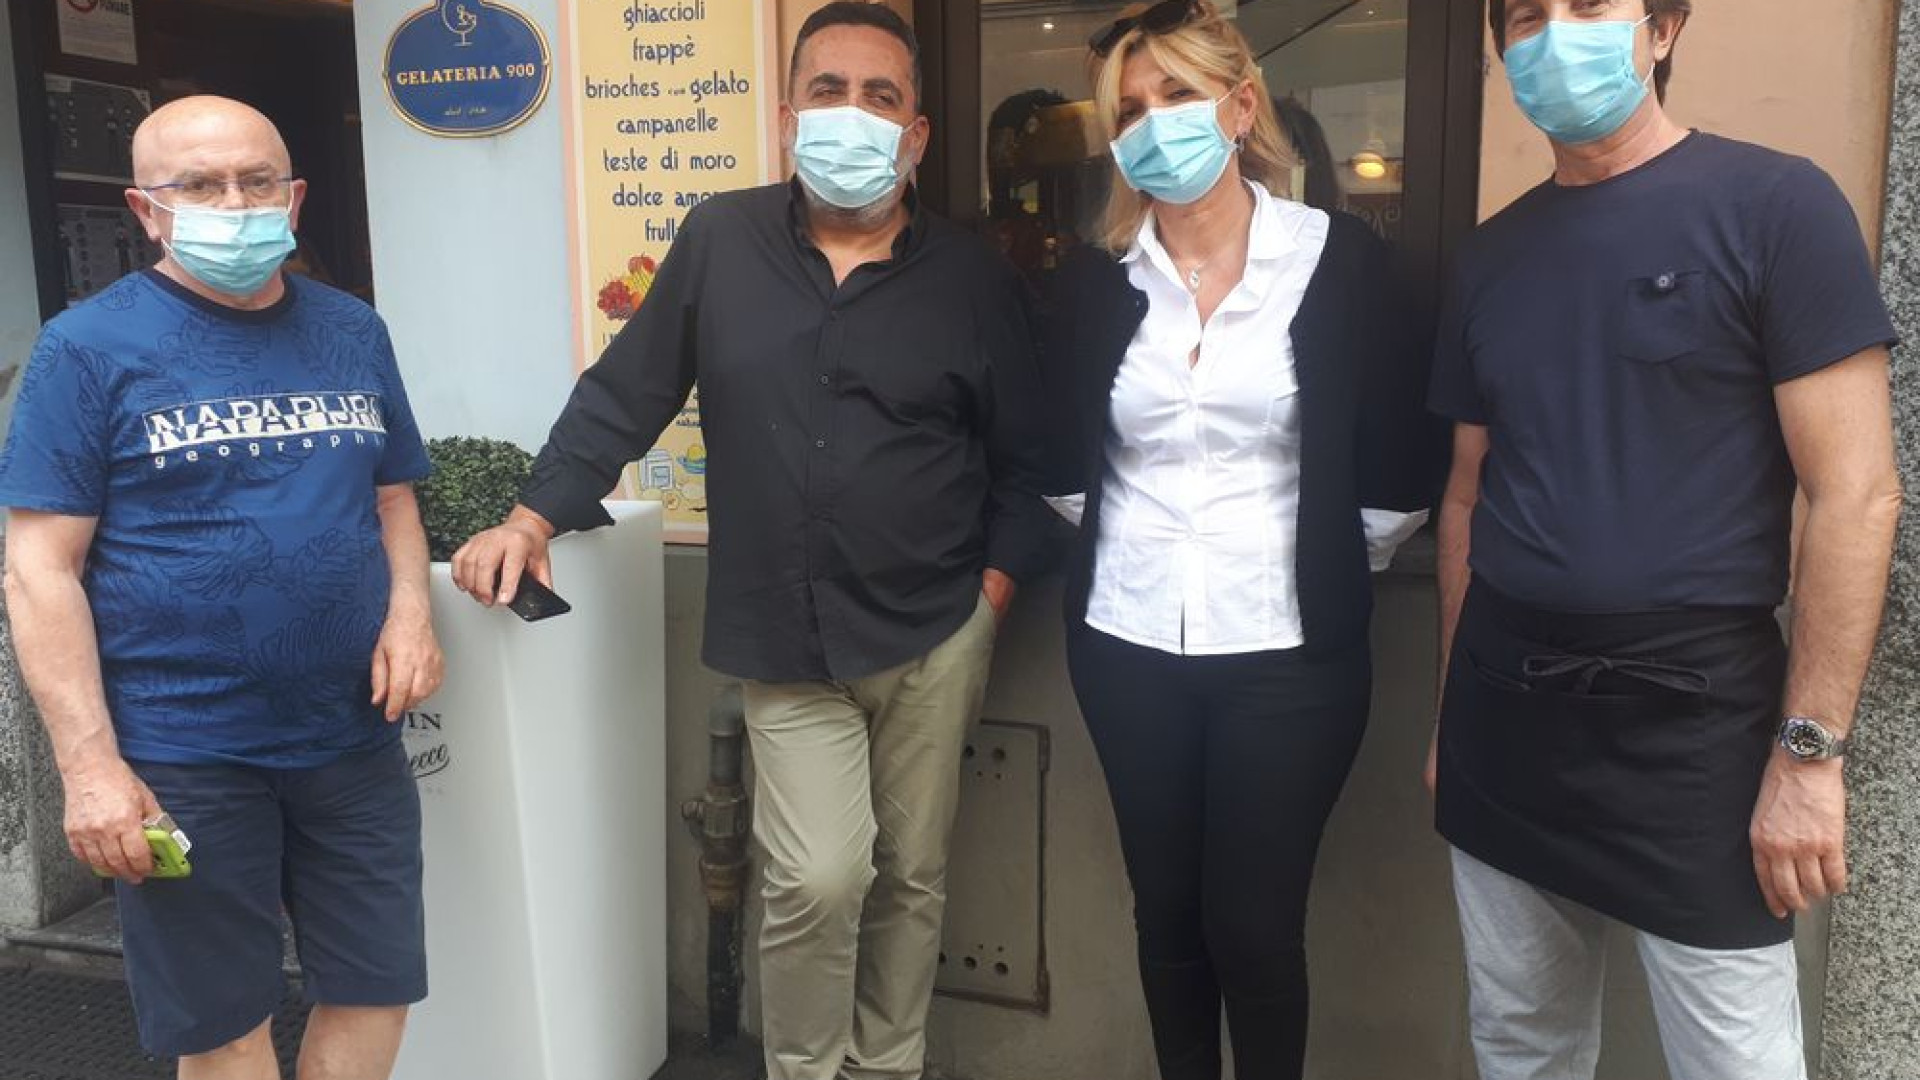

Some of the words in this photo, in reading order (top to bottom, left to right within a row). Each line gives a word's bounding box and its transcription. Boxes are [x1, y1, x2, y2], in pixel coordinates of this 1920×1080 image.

[623, 0, 705, 31] ghiaccioli
[633, 35, 696, 65] frappè
[397, 65, 502, 86] GELATERIA
[506, 63, 536, 79] 900
[585, 73, 660, 99] brioches
[690, 69, 750, 103] gelato
[616, 107, 719, 139] campanelle
[602, 147, 648, 172] teste
[660, 146, 679, 170] di
[690, 154, 737, 170] moro
[612, 182, 664, 207] dolce
[645, 218, 679, 242] frull
[408, 711, 442, 731] IN
